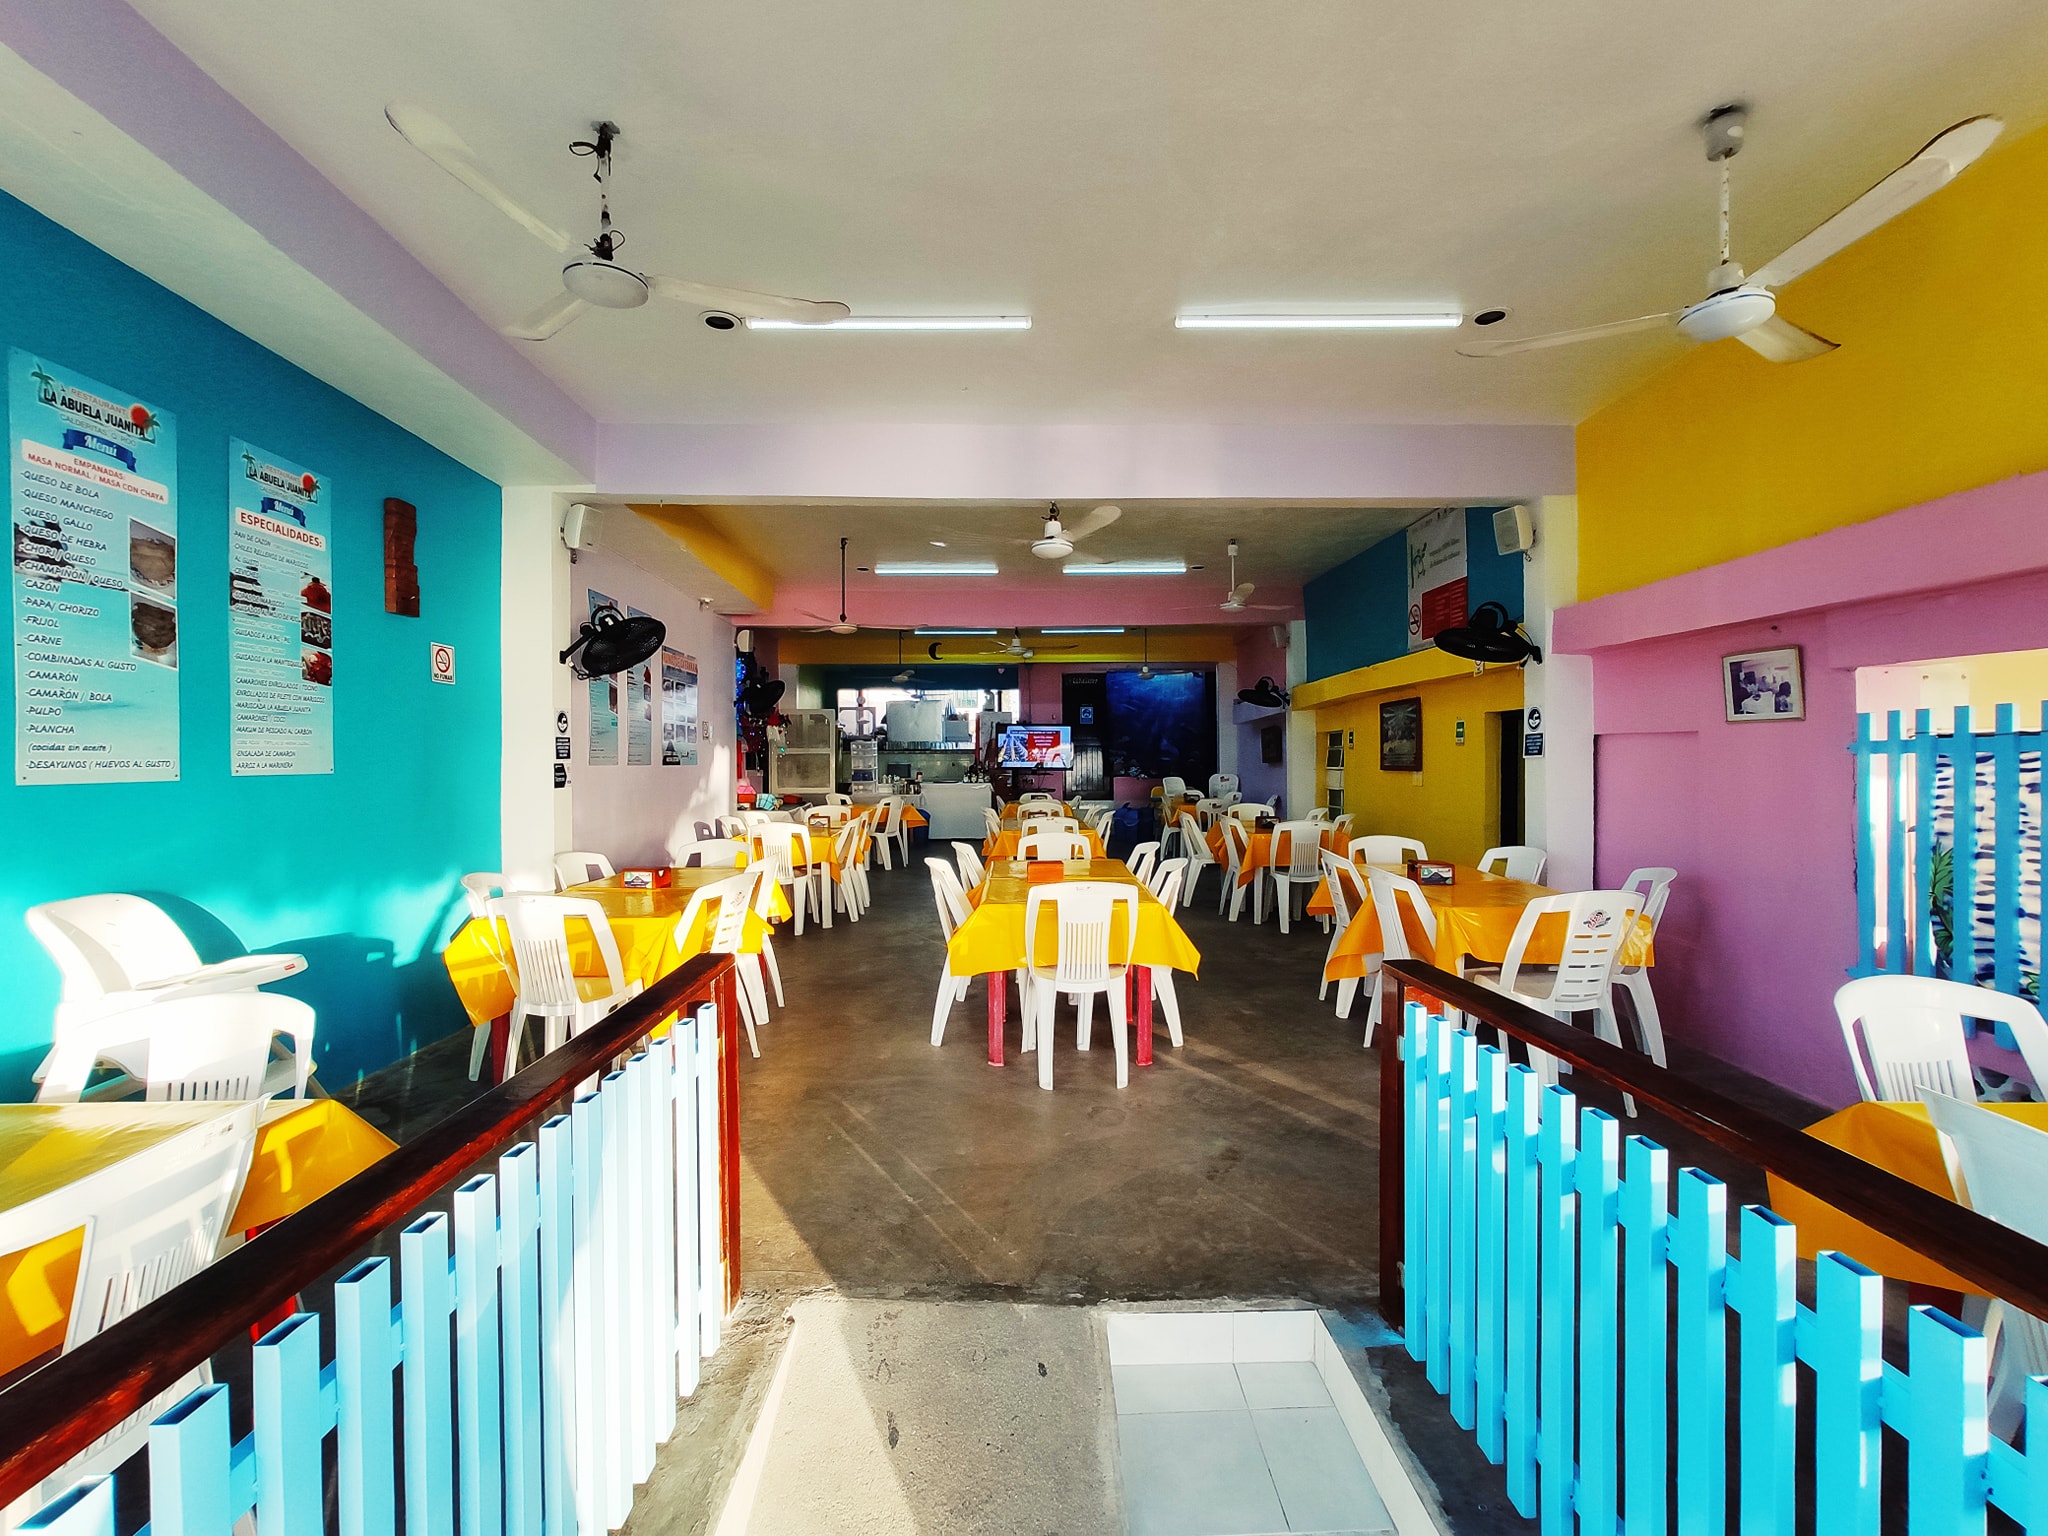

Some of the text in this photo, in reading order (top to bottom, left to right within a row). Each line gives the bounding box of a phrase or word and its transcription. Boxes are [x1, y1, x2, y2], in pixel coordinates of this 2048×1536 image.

[44, 389, 145, 436] LA ABUELA JUANITA
[84, 435, 117, 456] Menú
[28, 453, 52, 467] MASA
[55, 462, 91, 479] NORMAL
[99, 476, 120, 488] MASA
[123, 483, 138, 494] CON
[141, 489, 164, 501] CHAYA
[74, 458, 125, 480] EMPANADAS:
[60, 481, 73, 491] DE
[75, 486, 99, 499] BOLA
[249, 467, 311, 499] LA ABUELA JUANITA
[60, 499, 114, 520] MANCHEGO
[63, 517, 93, 531] GALLO
[241, 512, 322, 547] ESPECIALIDADES:
[61, 534, 73, 544] DE
[76, 539, 107, 551] HEBRA
[64, 552, 96, 565] QUESO
[93, 575, 123, 588] QUESO
[59, 603, 99, 616] CHORIZO
[94, 660, 105, 668] AL
[108, 661, 136, 671] GUSTO
[90, 693, 112, 701] BOLA
[68, 744, 80, 752] sin
[94, 760, 130, 768] HUEVOS
[132, 760, 143, 768] AL
[145, 760, 170, 768] GUSTO
